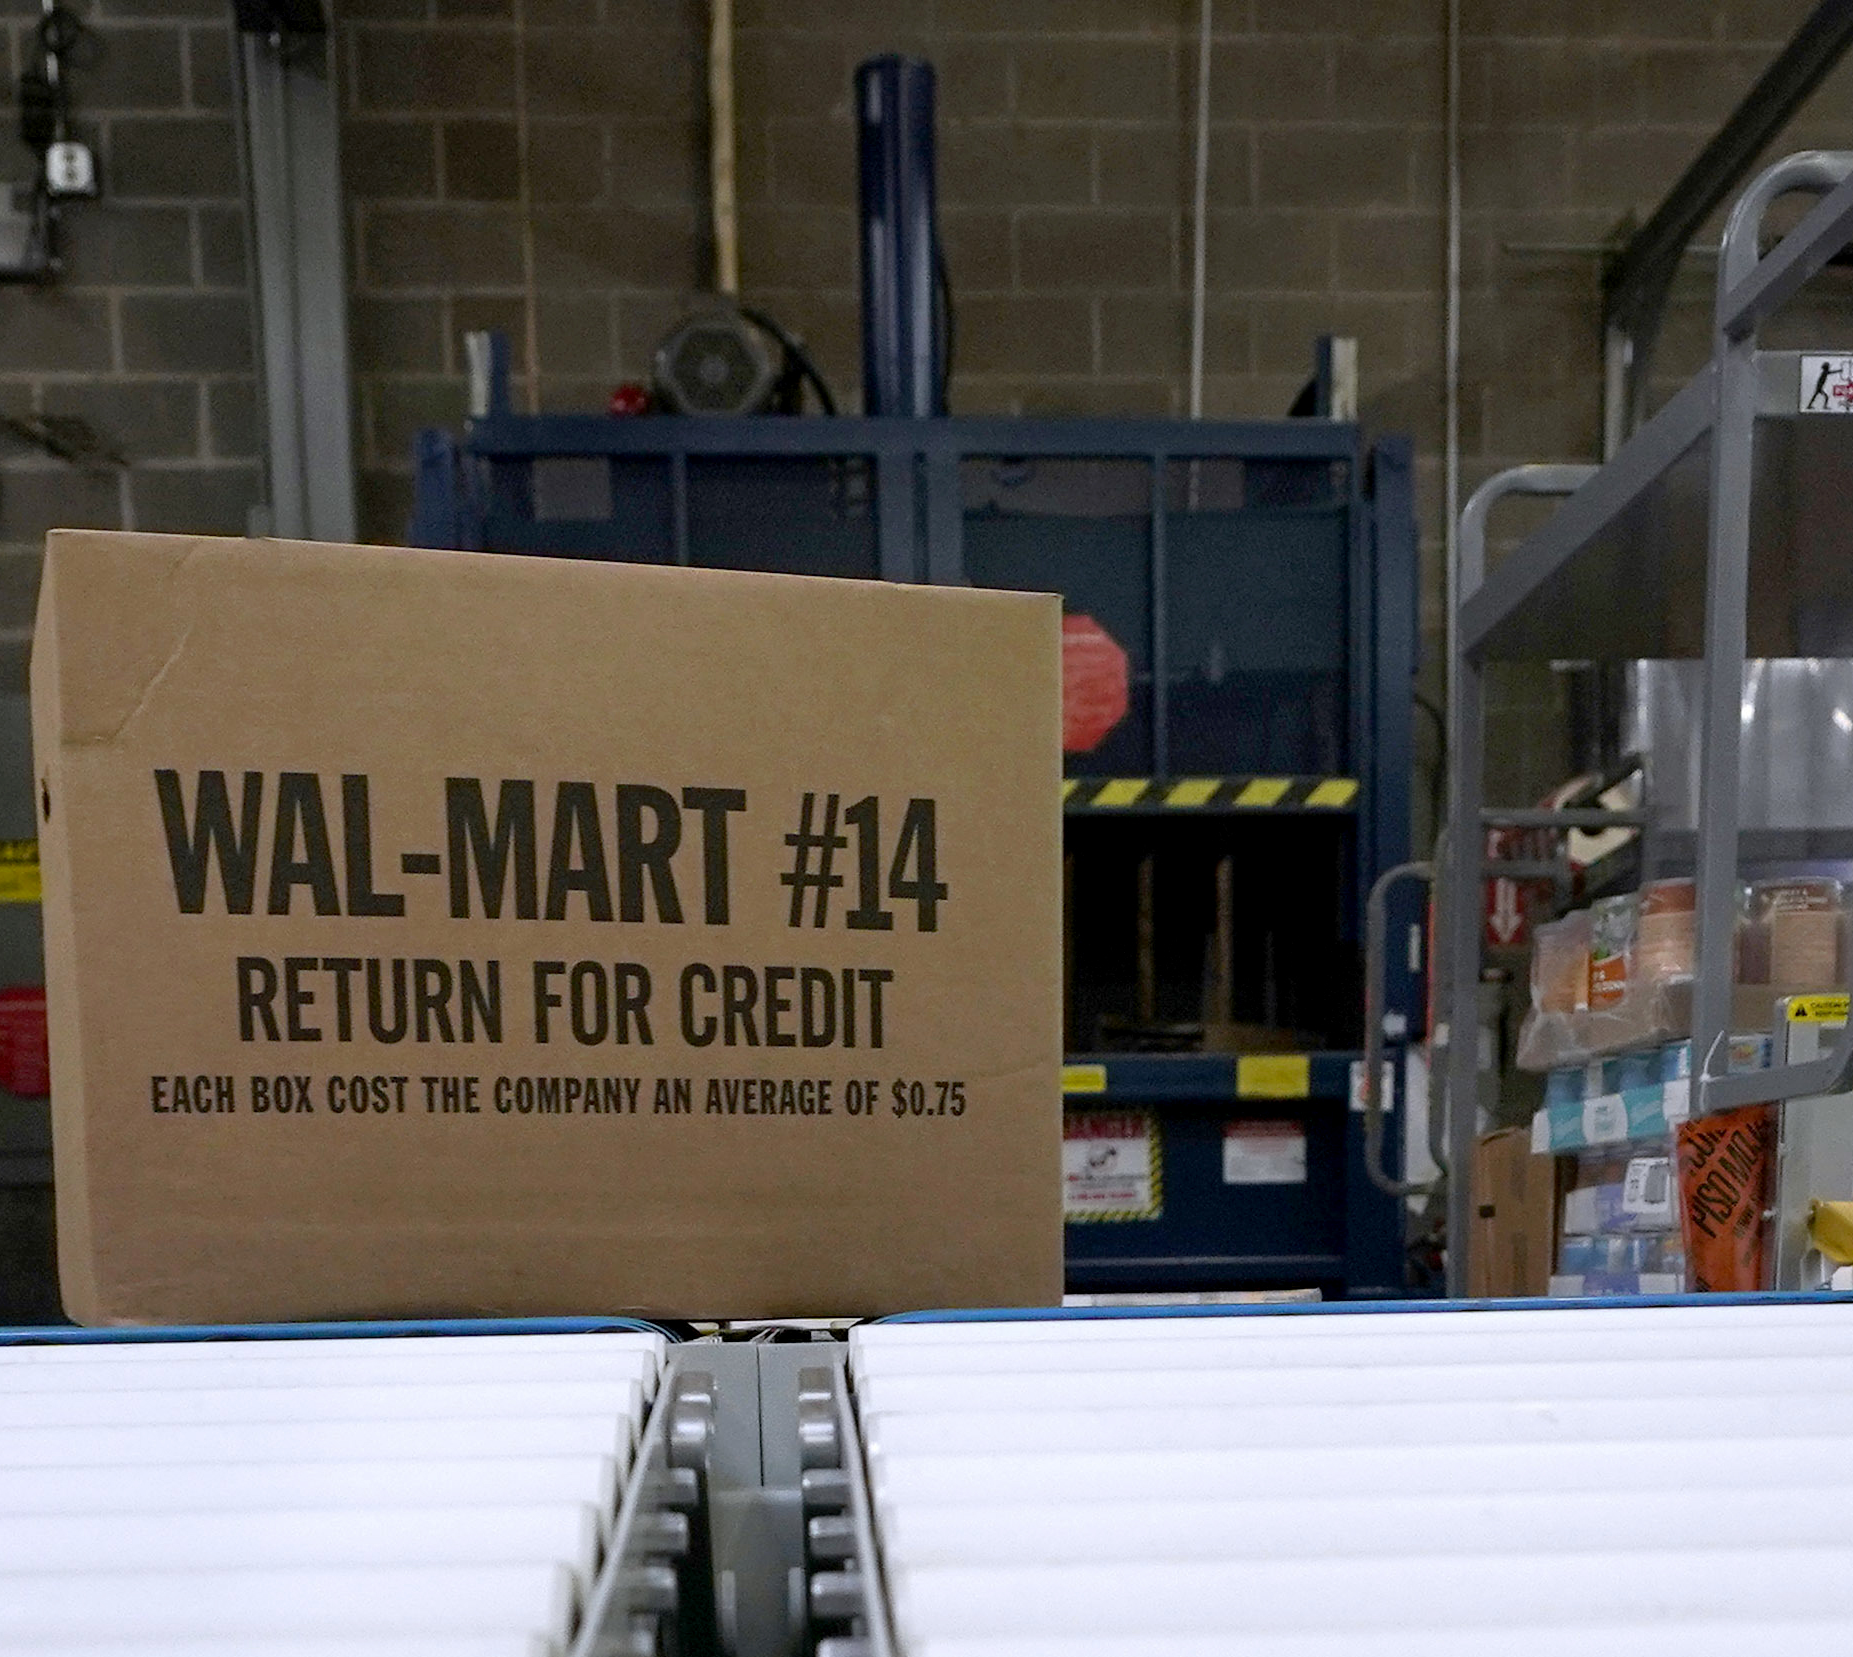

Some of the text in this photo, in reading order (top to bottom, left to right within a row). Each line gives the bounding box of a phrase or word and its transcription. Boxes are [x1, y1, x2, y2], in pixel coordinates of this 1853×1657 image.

[153, 768, 949, 934] WAL-MART #14
[235, 955, 895, 1050] RETURN FOR CREDIT
[150, 1073, 967, 1120] EACH BOX COST THE COMPANY AN AVERAGE OF $0.75
